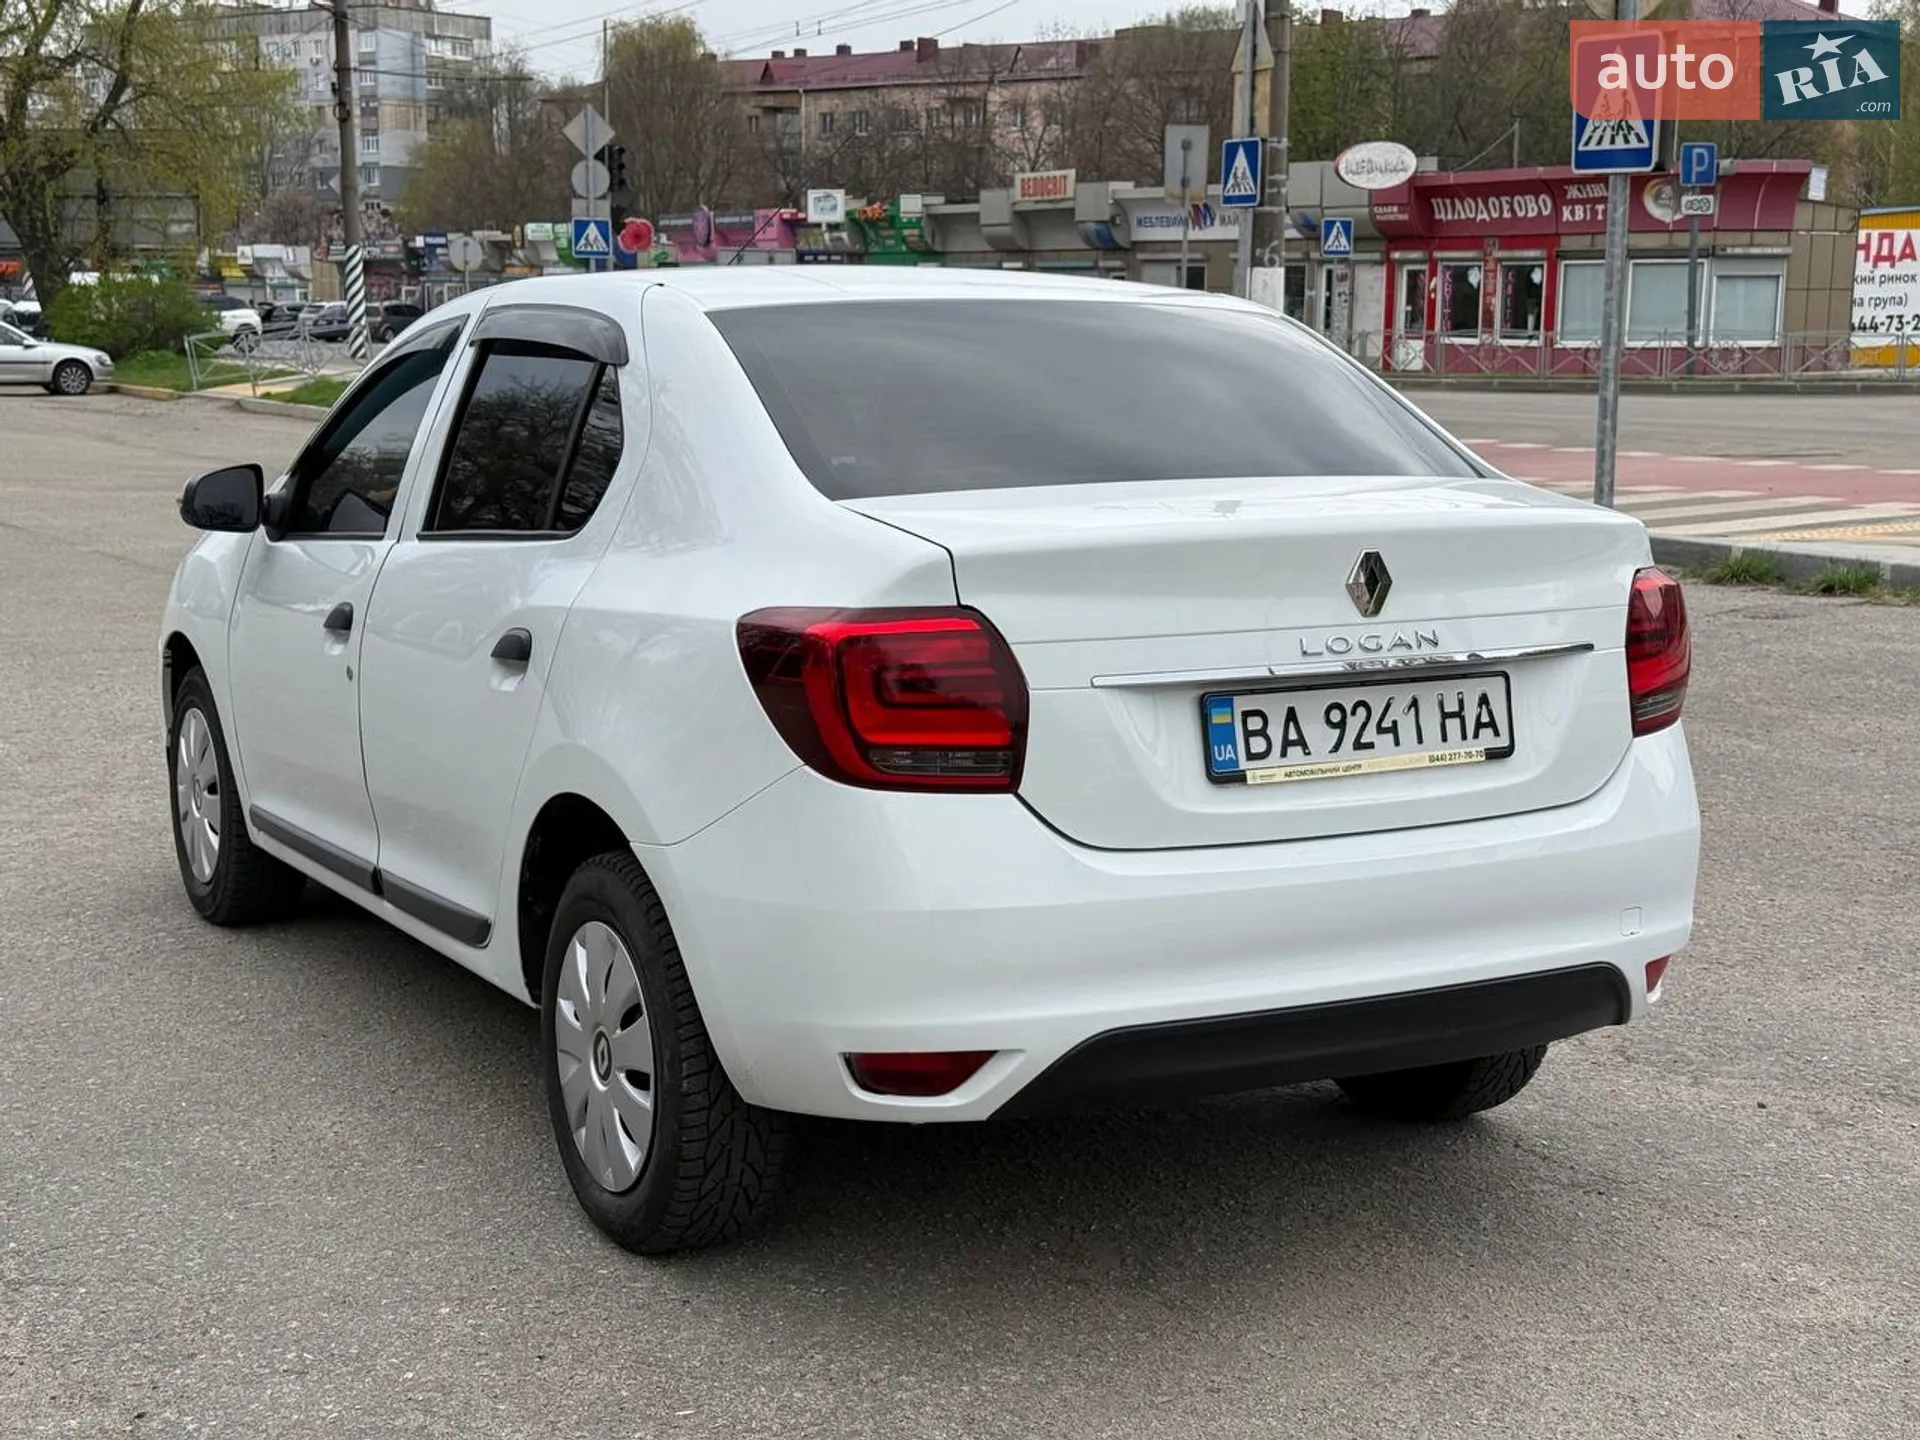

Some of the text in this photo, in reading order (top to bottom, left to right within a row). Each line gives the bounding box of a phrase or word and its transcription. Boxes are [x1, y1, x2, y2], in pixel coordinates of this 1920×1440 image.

[1562, 203, 1611, 222] КВІТ
[1879, 273, 1917, 287] ринок
[1868, 292, 1908, 310] група)
[1851, 314, 1920, 333] 44-73-2
[1299, 629, 1440, 657] LOGAN
[1241, 689, 1501, 761] BA 9241 HA
[1214, 744, 1236, 761] UA
